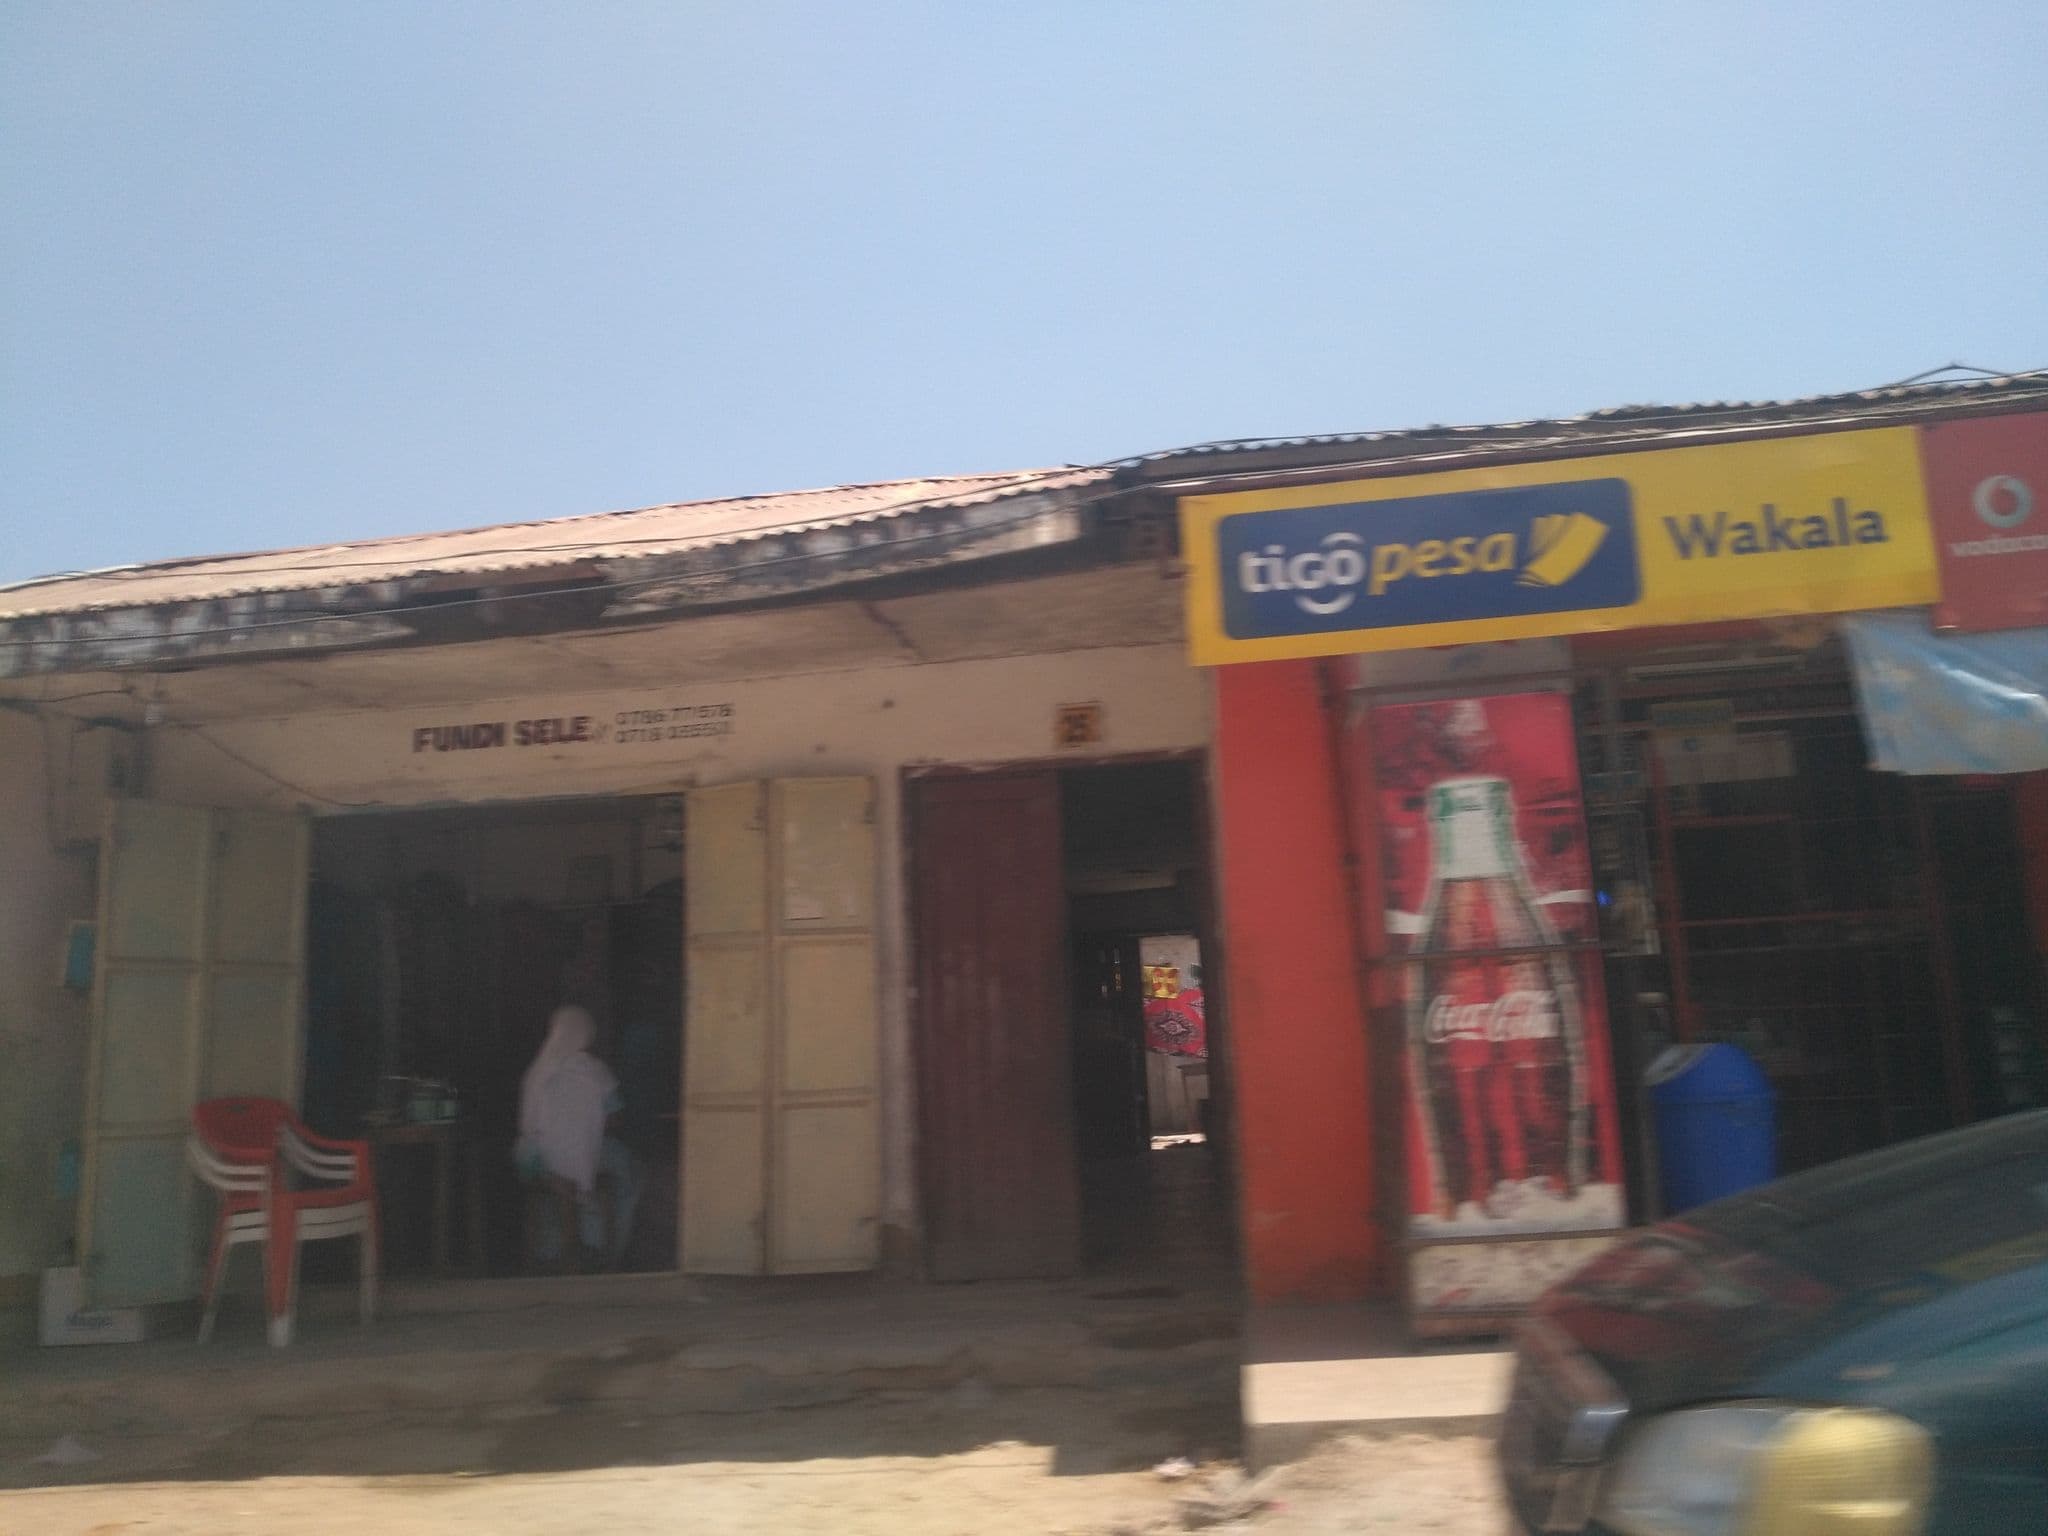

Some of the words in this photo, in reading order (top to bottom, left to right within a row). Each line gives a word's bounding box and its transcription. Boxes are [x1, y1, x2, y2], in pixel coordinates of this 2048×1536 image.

[1662, 497, 1888, 561] Wakala
[1945, 535, 2048, 557] vodaco
[1367, 533, 1517, 596] pesa
[413, 722, 505, 753] FUNDI
[514, 715, 593, 746] SELE
